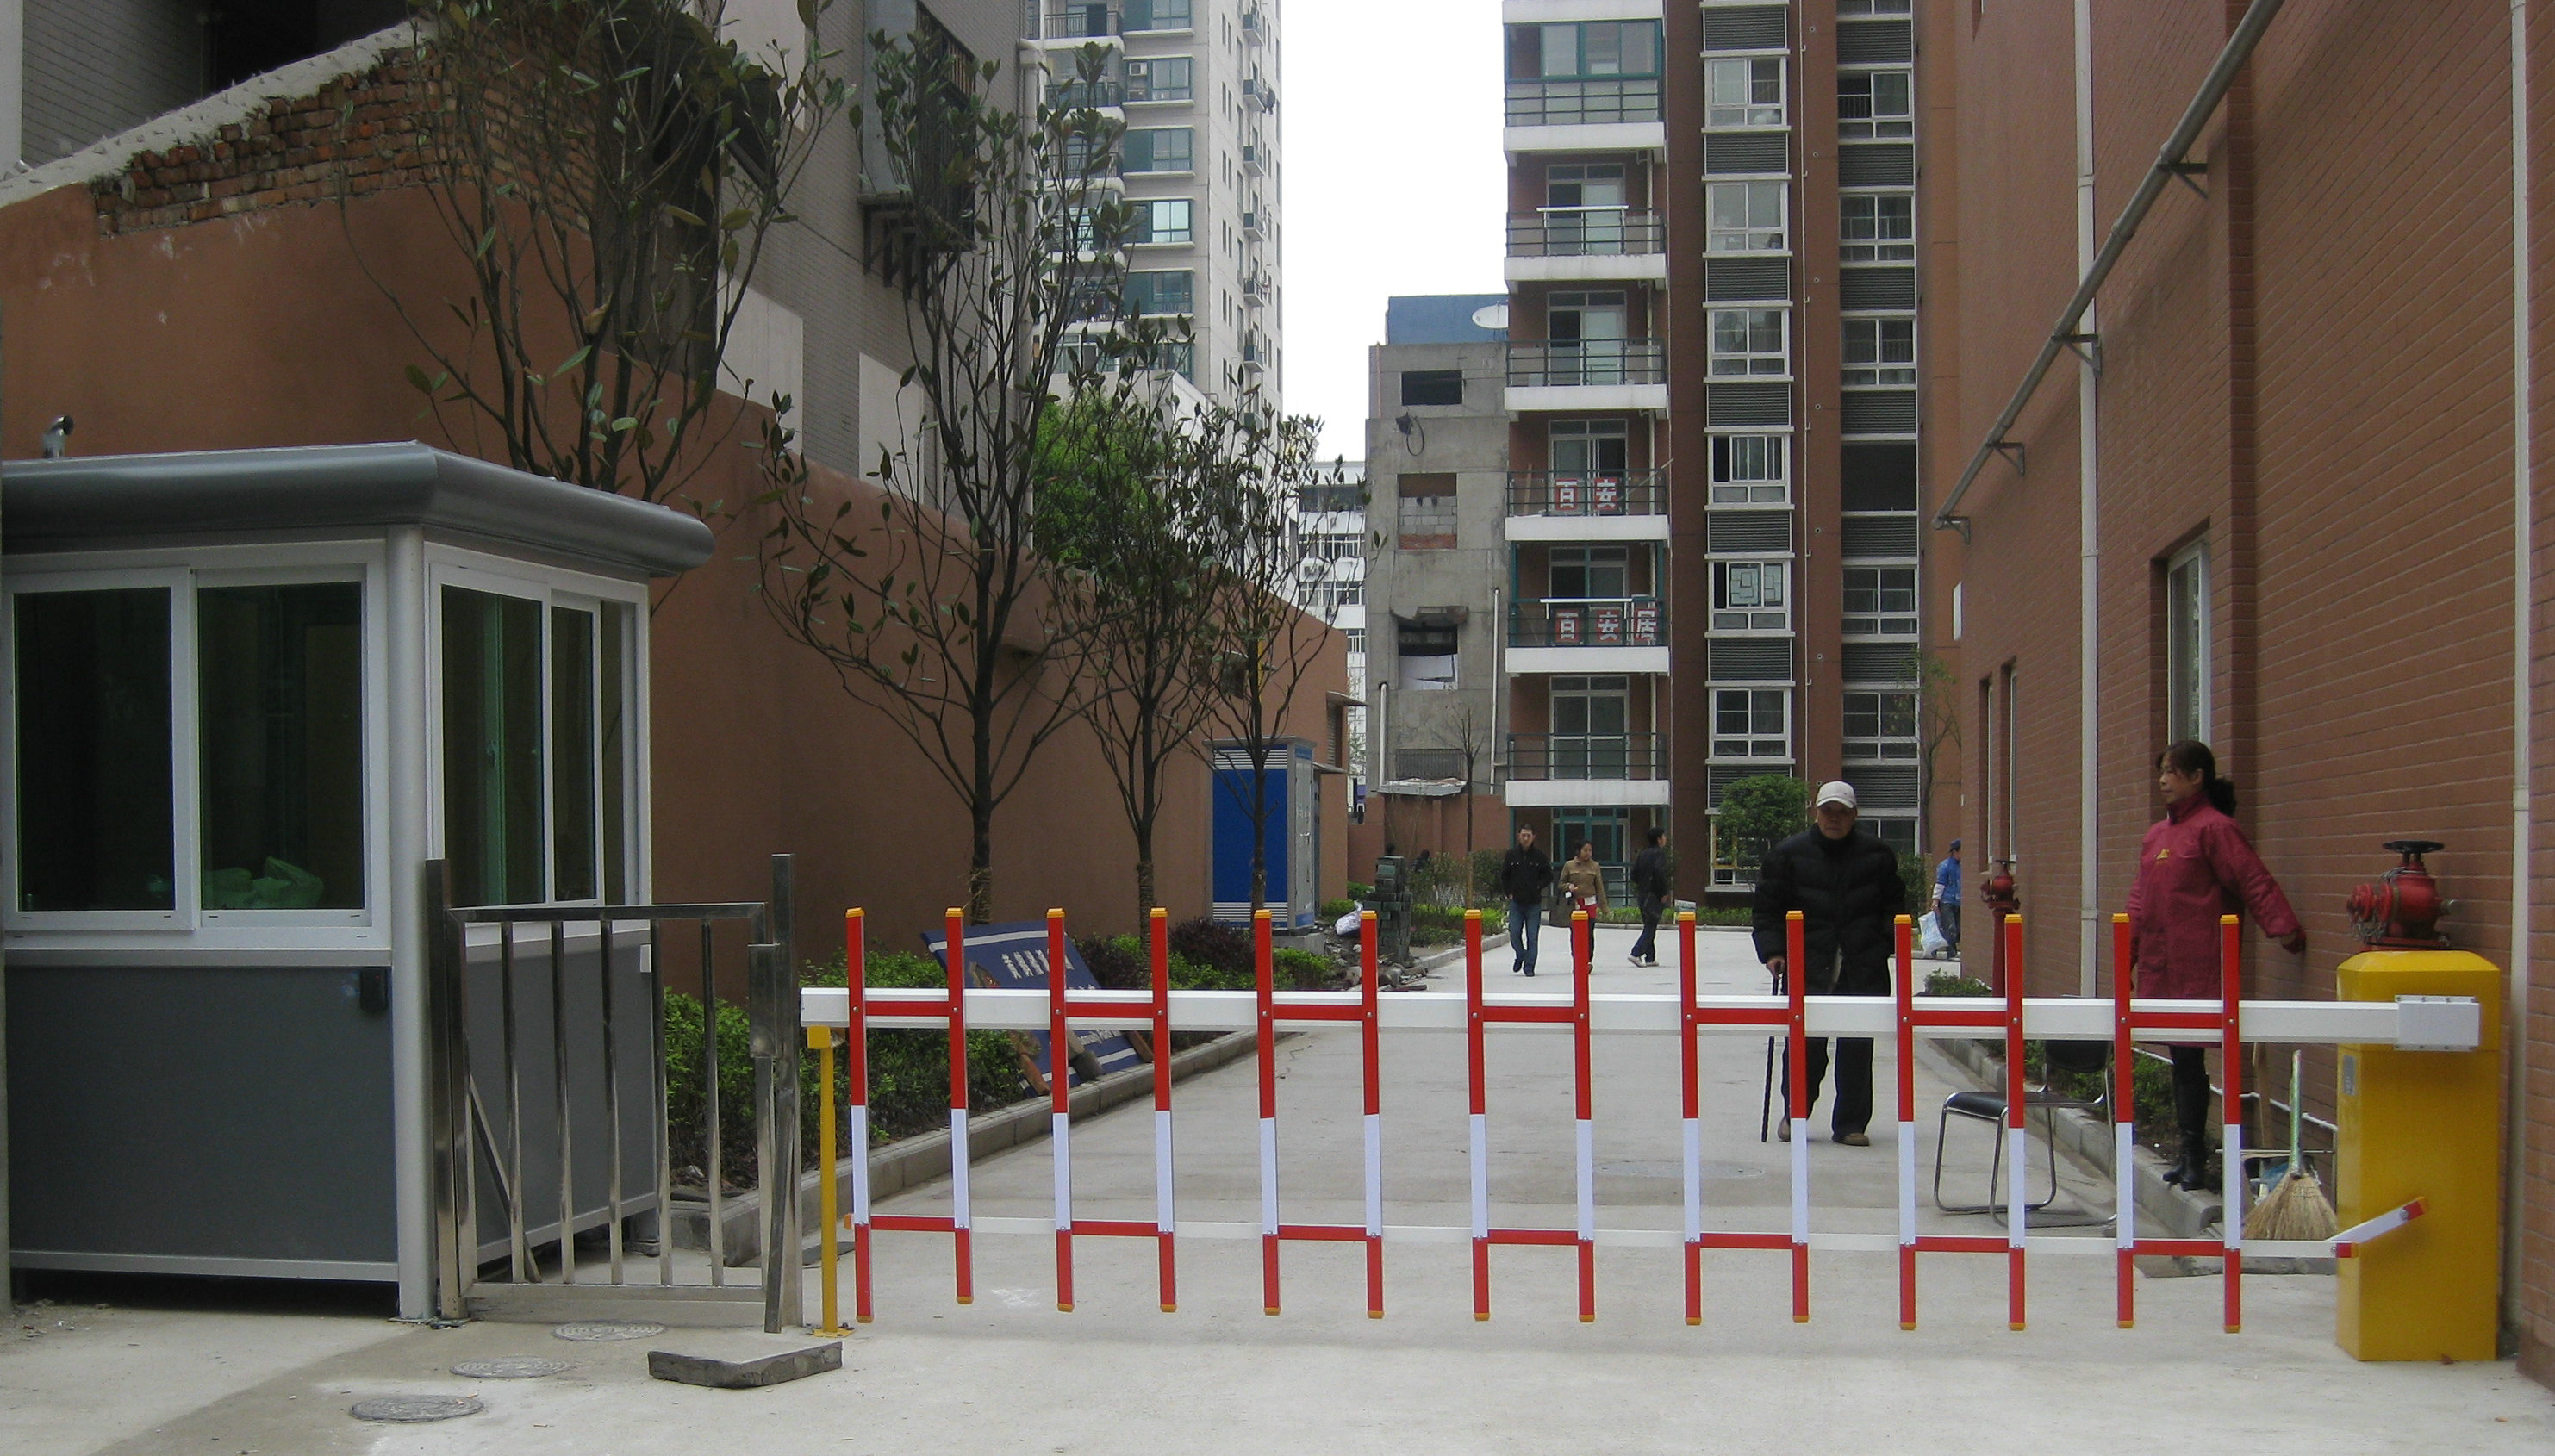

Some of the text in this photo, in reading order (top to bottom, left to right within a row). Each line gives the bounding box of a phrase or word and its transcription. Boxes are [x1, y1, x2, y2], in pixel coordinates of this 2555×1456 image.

[1556, 479, 1616, 508] 百安
[1556, 610, 1656, 640] 百安居
